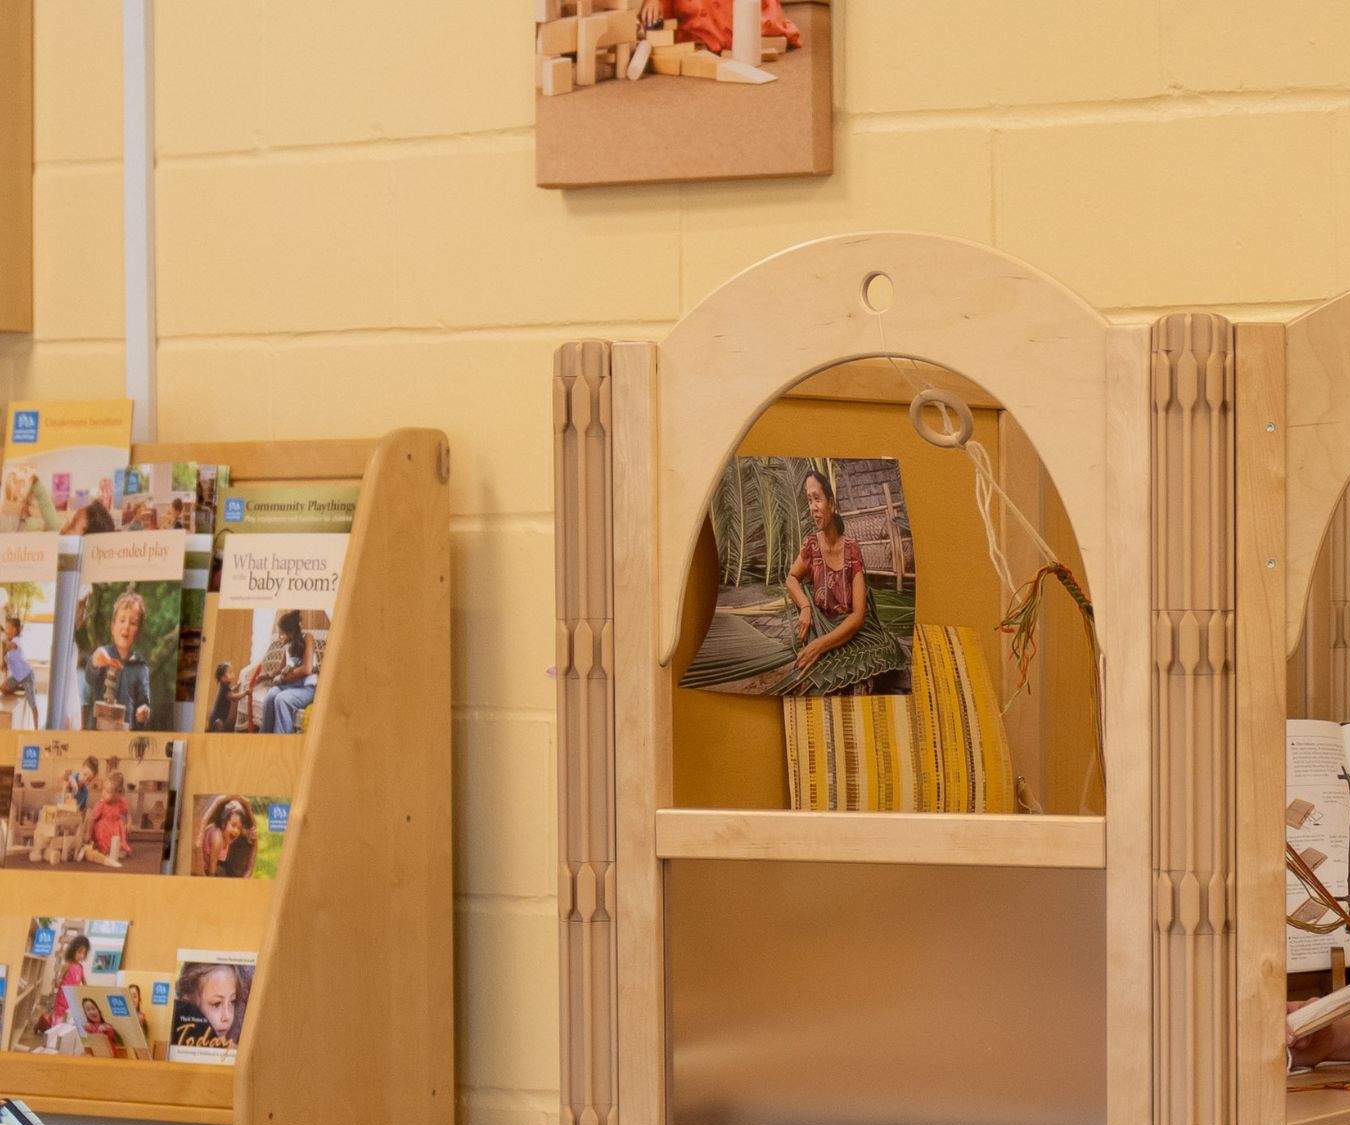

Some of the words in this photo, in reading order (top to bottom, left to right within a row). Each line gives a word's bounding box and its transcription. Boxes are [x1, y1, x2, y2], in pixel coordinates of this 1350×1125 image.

[245, 499, 304, 512] Community
[307, 499, 356, 514] Playthings
[91, 543, 146, 564] Open-ended
[147, 541, 169, 561] play
[233, 553, 266, 571] What
[271, 552, 328, 575] happens
[248, 571, 284, 597] baby
[287, 572, 339, 592] room?
[176, 1023, 234, 1061] Today
